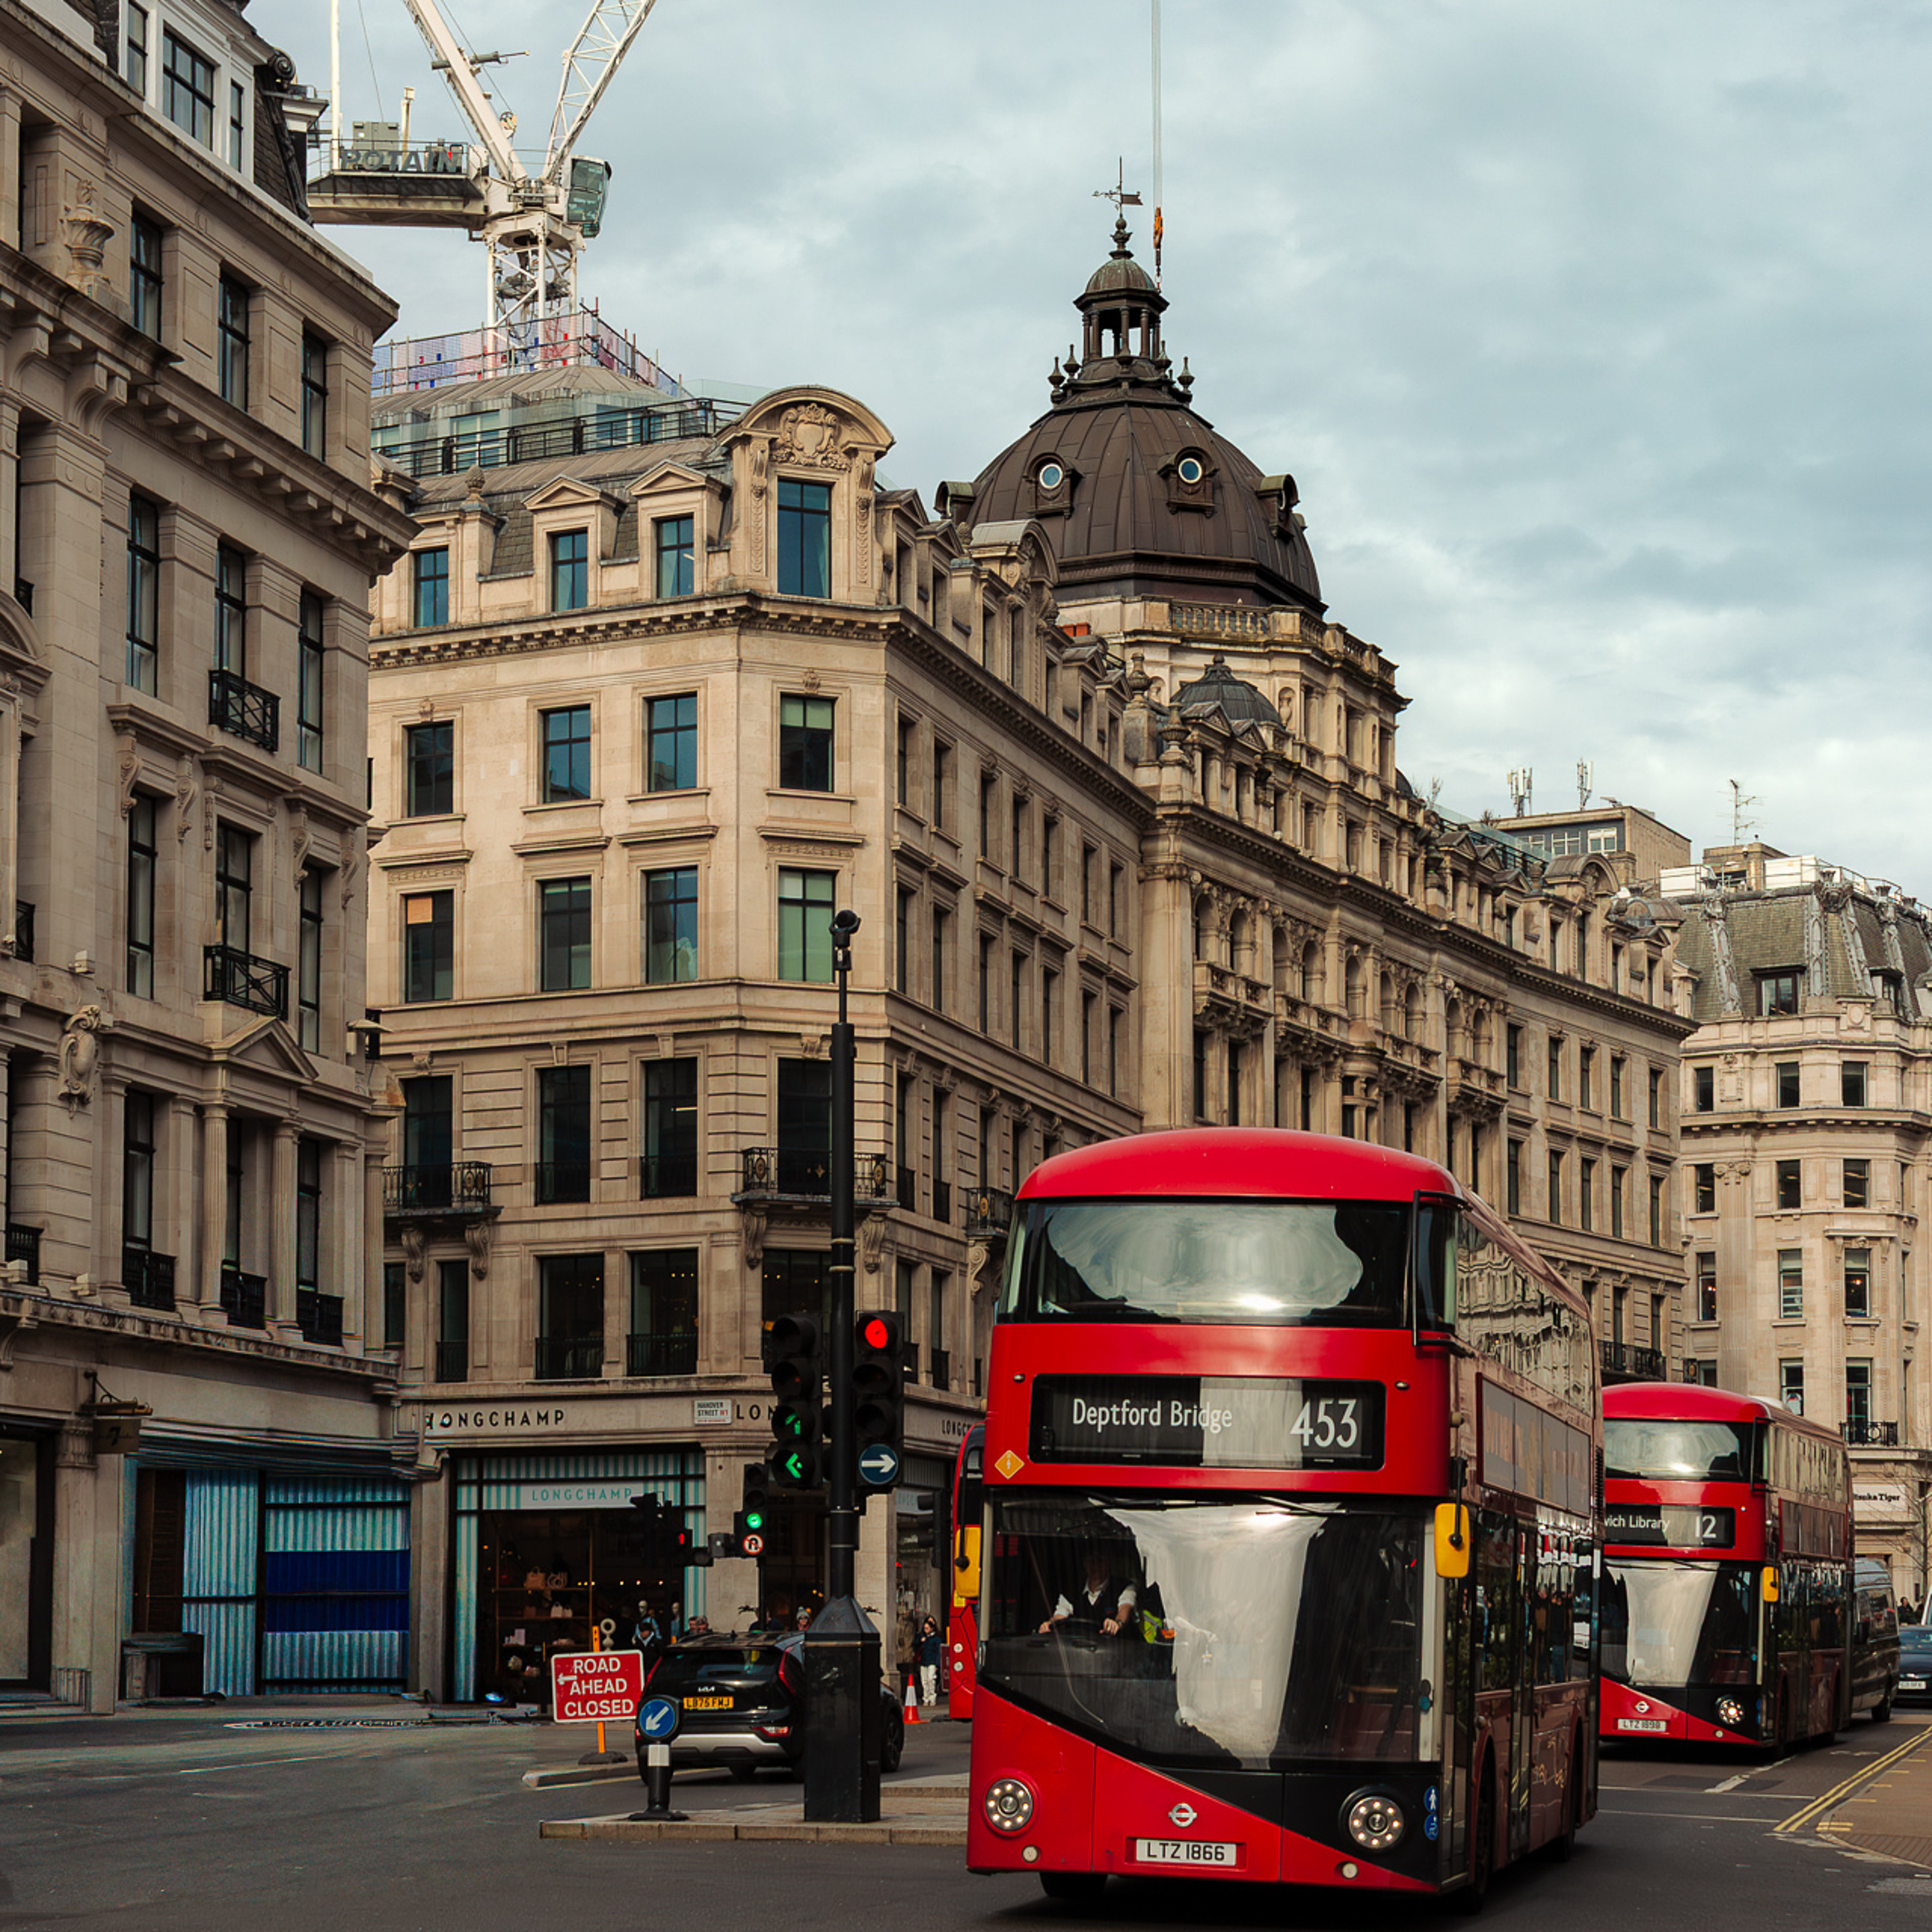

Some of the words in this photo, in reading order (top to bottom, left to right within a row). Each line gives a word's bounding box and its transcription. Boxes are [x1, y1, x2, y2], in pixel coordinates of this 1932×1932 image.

[341, 149, 459, 172] POTAIN
[1073, 1398, 1161, 1432] Deptford
[1170, 1401, 1232, 1433] Bridge
[1290, 1398, 1357, 1447] 453
[941, 1419, 972, 1437] LONGC
[532, 1488, 632, 1501] LONGCHAMP
[1629, 1515, 1670, 1533] Library
[1695, 1515, 1717, 1539] 12
[573, 1657, 621, 1674] ROAD
[570, 1678, 627, 1696] AHEAD
[564, 1699, 634, 1717] CLOSED
[1147, 1841, 1181, 1859] LTZ
[1186, 1843, 1225, 1861] 1866
